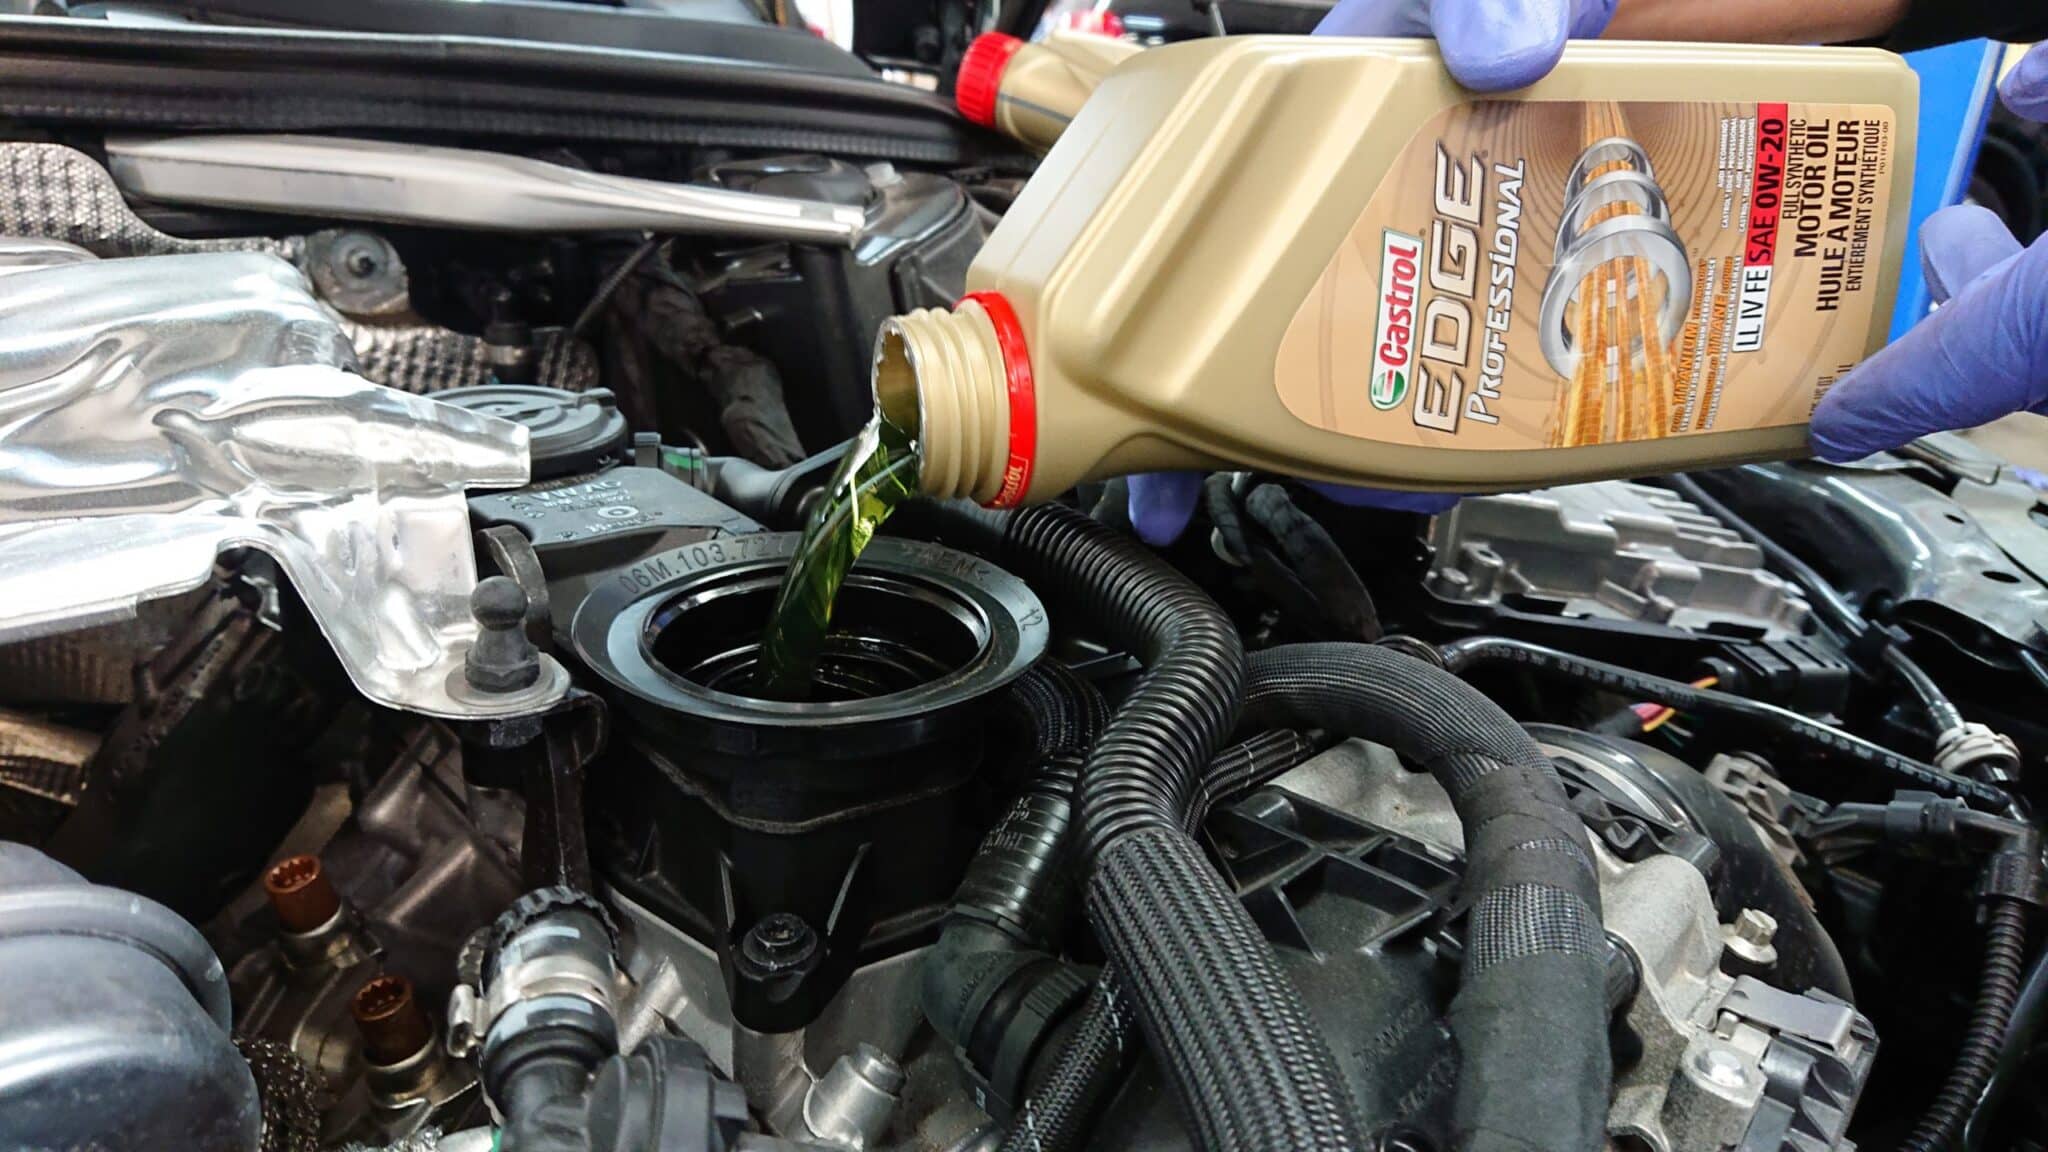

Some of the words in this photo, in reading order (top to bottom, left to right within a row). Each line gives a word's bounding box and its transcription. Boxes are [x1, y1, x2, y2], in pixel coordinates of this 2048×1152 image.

[1755, 118, 1784, 210] 0W-20
[1785, 119, 1807, 189] SYNTHETIC
[1805, 118, 1830, 159] OIL
[1829, 120, 1860, 220] MOTEUR
[1782, 191, 1801, 220] FULL
[1794, 165, 1827, 257] MOTOR
[1749, 215, 1776, 263] SAE
[1379, 244, 1419, 367] Castrol
[1412, 140, 1485, 434] EDGE
[1464, 158, 1525, 424] PROFESSIONAL
[1700, 258, 1717, 324] PERFORMANCE
[1740, 299, 1764, 319] IV
[1744, 269, 1768, 293] FE
[1815, 247, 1846, 311] HUILE
[1694, 326, 1709, 370] MAXIMUM
[1707, 294, 1728, 356] TITANE
[1736, 324, 1760, 346] LL
[1672, 322, 1700, 406] TITANIUM
[530, 487, 578, 501] VW
